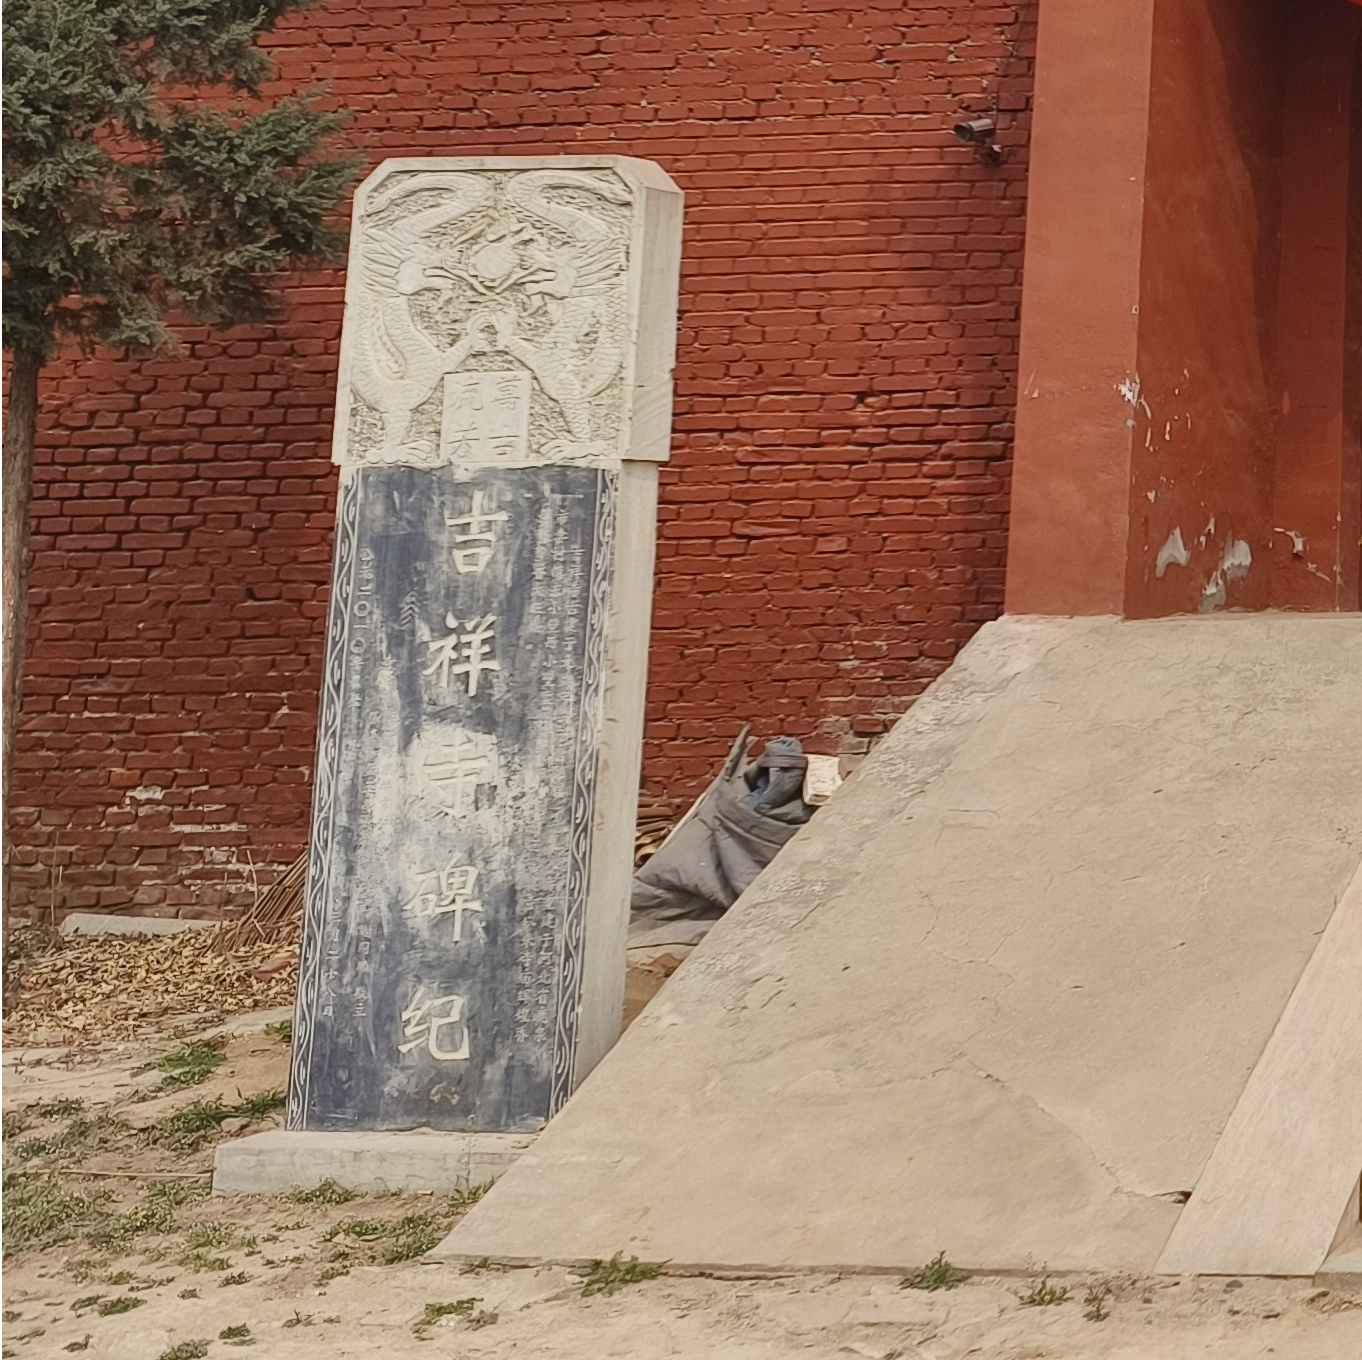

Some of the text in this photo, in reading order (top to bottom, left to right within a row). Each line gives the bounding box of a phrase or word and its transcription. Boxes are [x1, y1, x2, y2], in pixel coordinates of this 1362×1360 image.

[398, 489, 509, 1060] 吉祥寺碑纪
